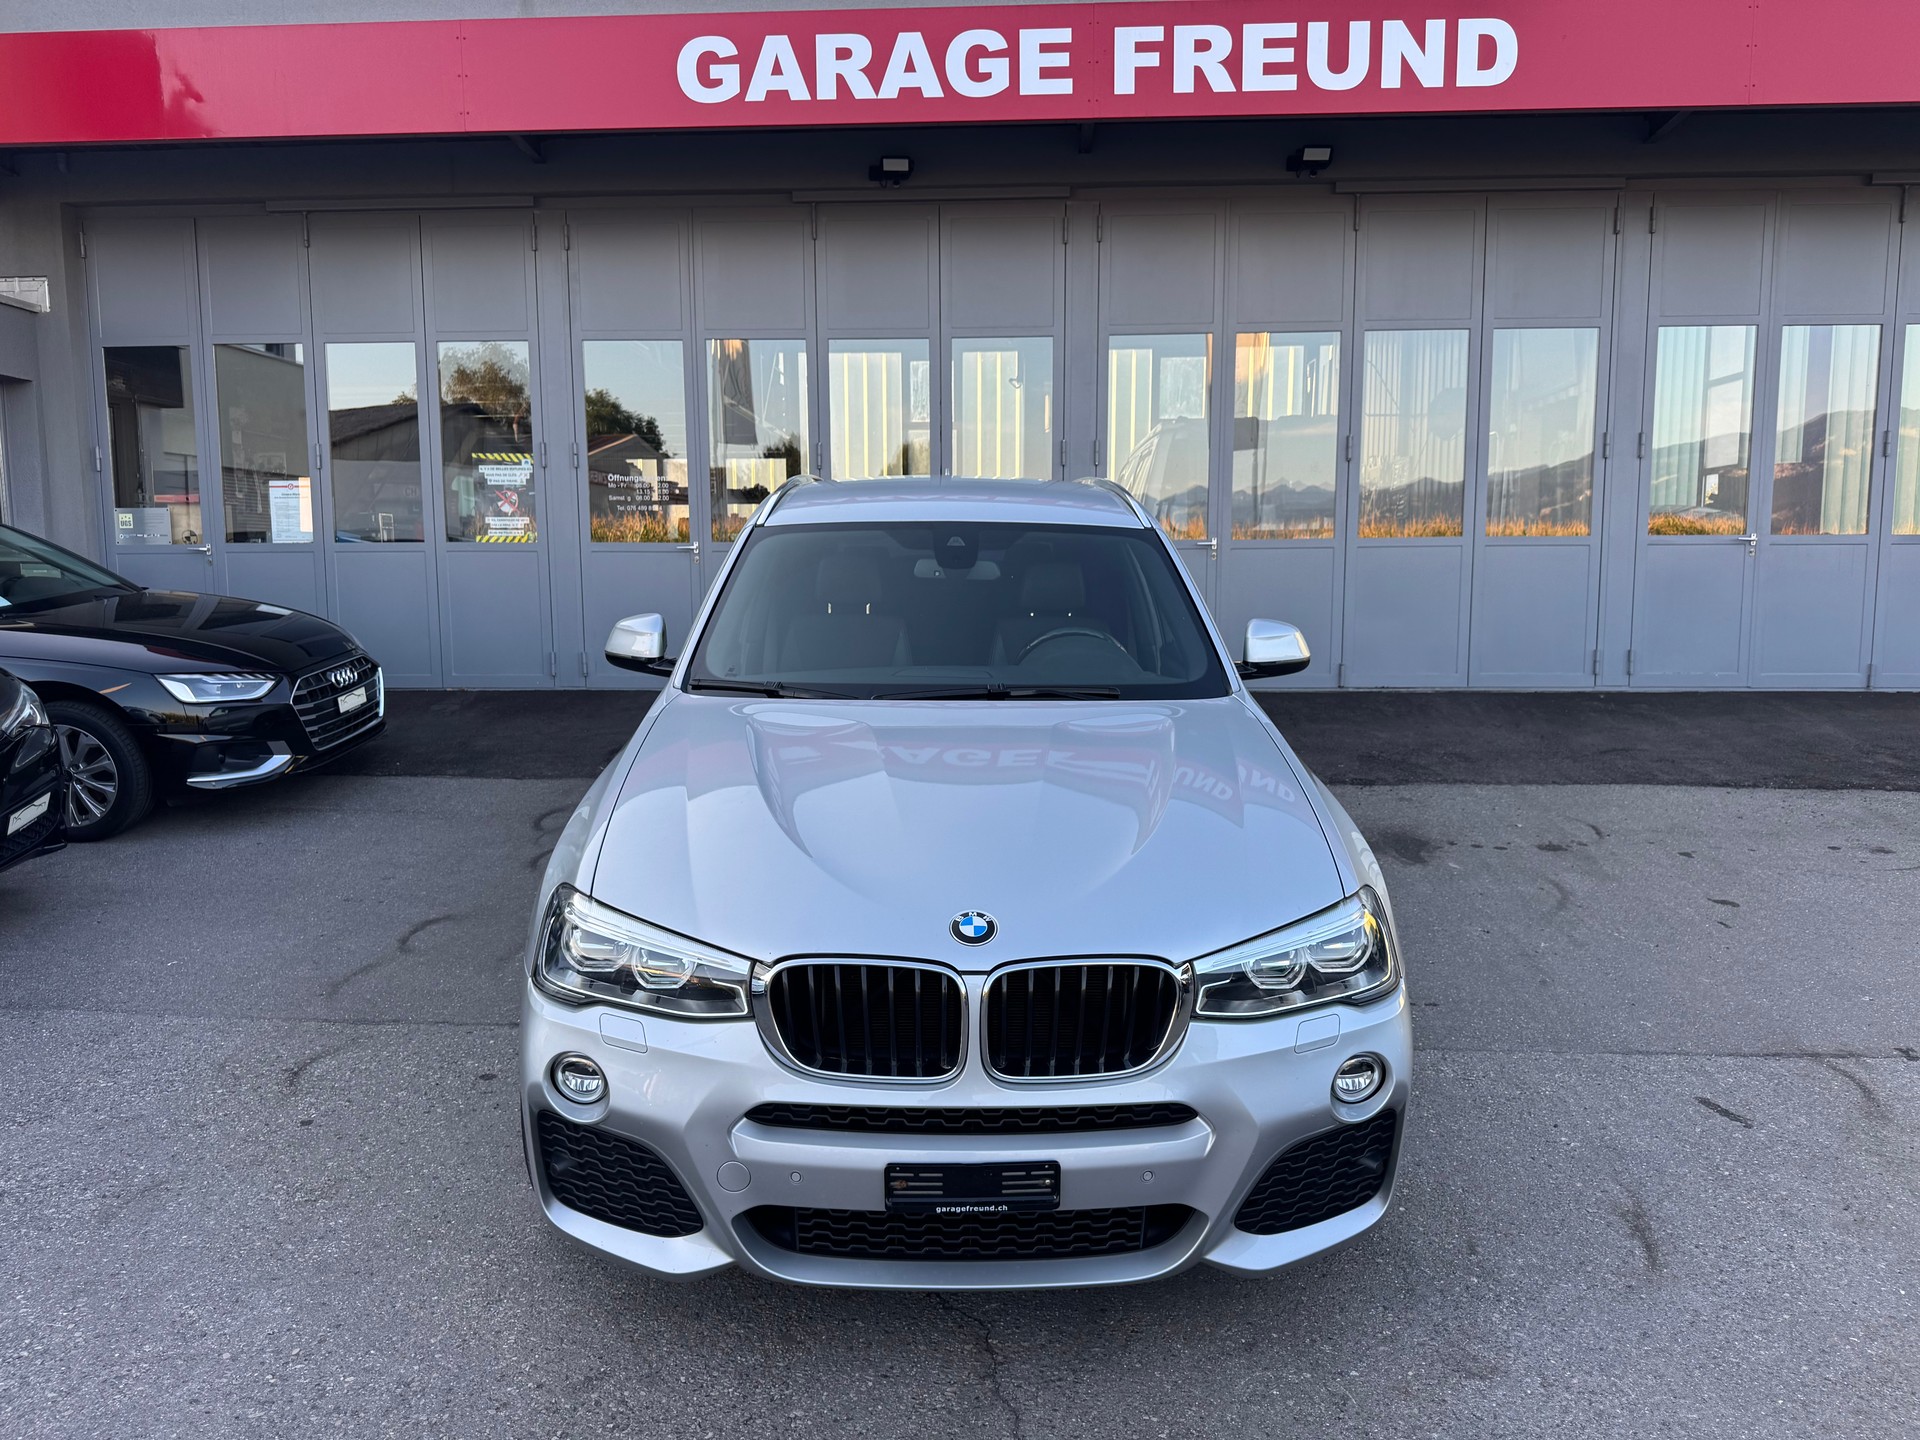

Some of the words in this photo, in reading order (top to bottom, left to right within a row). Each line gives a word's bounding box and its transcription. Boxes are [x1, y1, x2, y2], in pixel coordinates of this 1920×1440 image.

[676, 28, 1074, 104] GARAGE
[1113, 17, 1519, 95] FREUND
[935, 1204, 1008, 1214] garagefreund.ch
